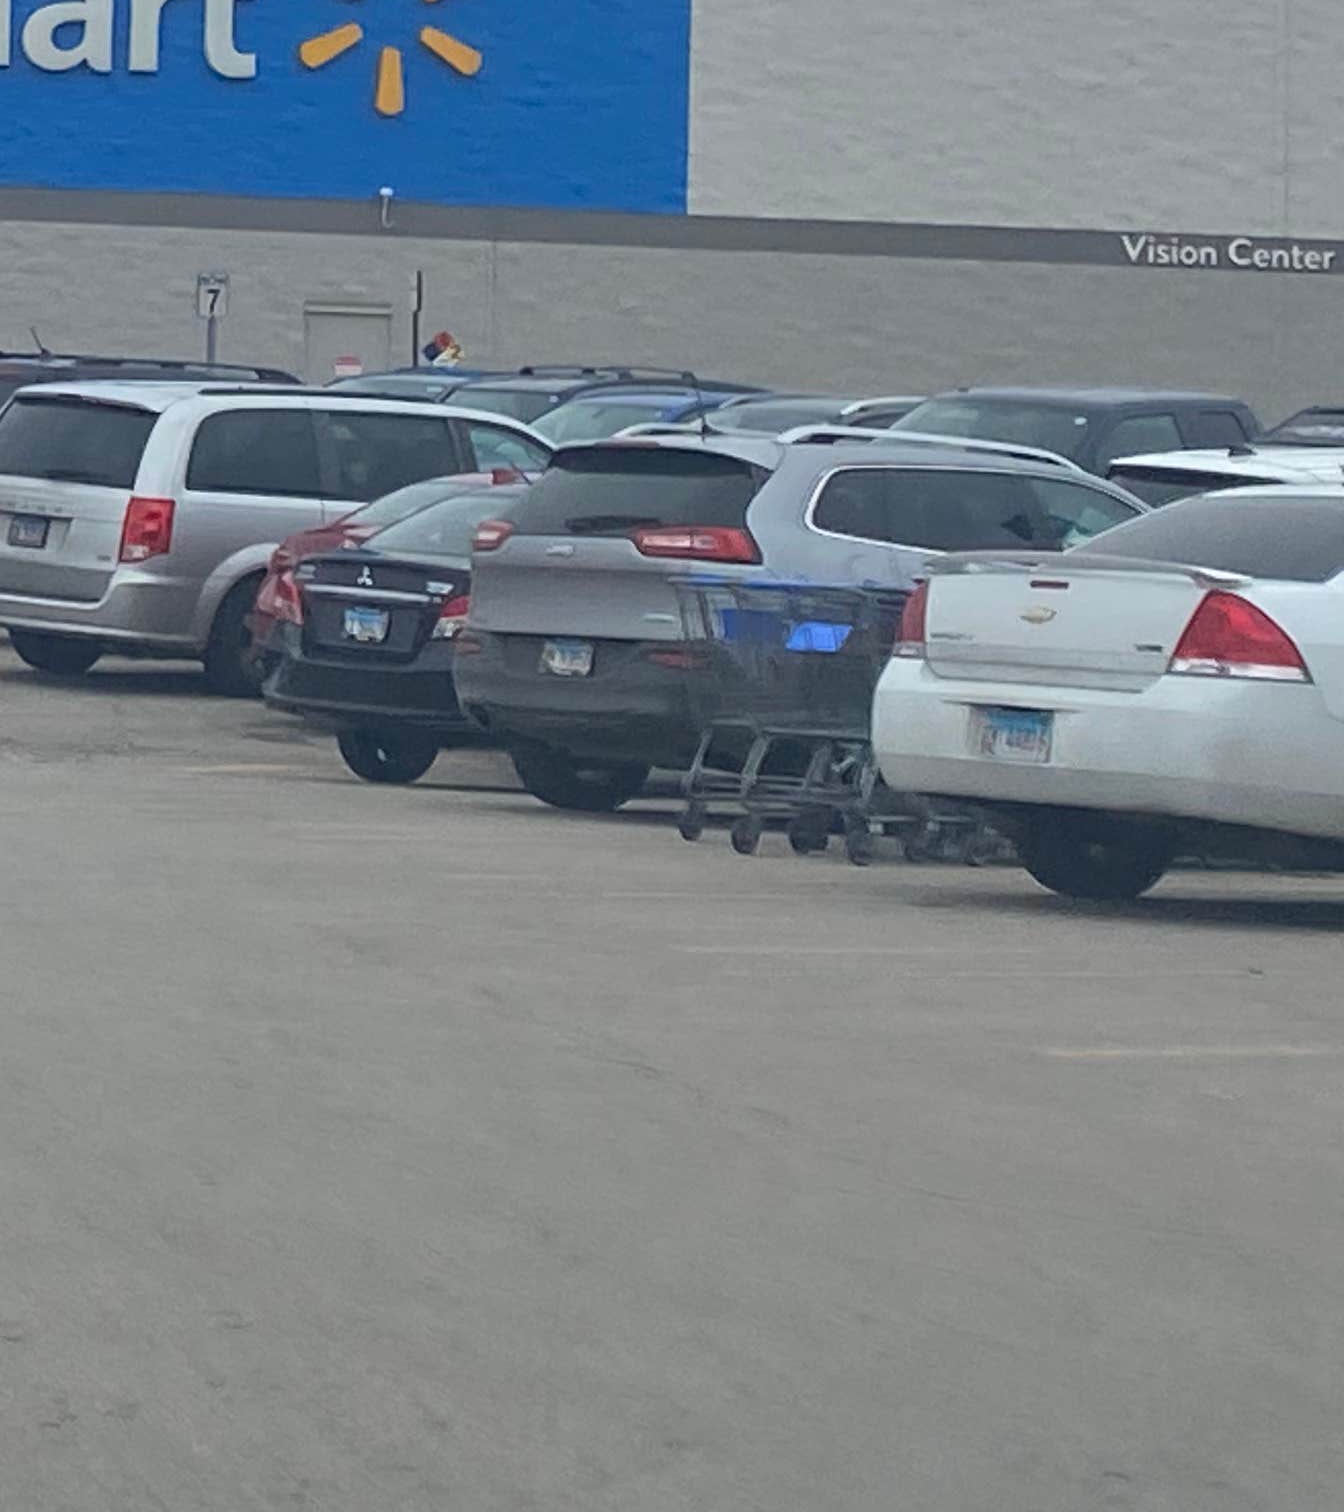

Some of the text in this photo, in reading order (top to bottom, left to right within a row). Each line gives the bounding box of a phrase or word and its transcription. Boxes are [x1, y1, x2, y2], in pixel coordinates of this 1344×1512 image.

[1120, 234, 1337, 270] Vision Center
[207, 288, 221, 313] 7
